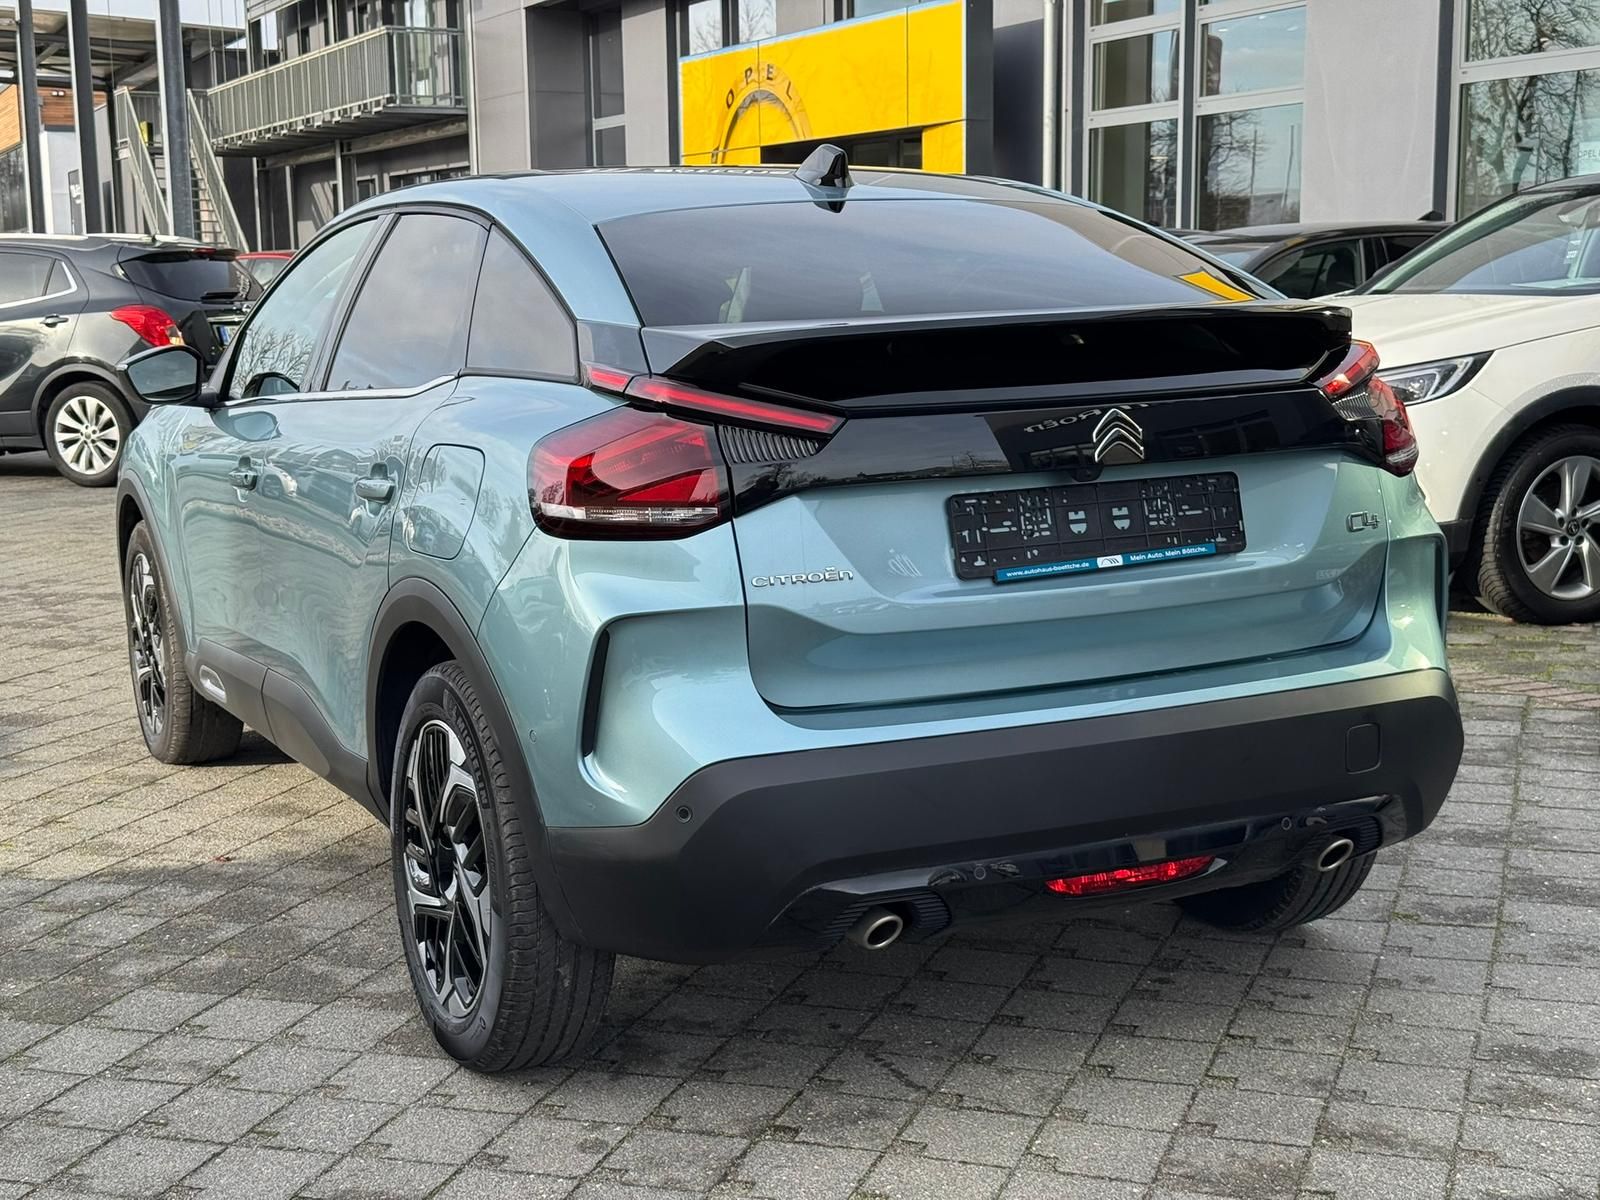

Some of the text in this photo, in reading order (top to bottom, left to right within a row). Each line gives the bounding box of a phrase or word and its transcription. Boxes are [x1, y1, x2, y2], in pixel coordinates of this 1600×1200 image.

[726, 63, 792, 110] OPEL
[1345, 510, 1380, 532] C4
[1130, 546, 1208, 561] Mein Auto. Mein Böttche.
[1006, 562, 1090, 577] www.autohaus-boettche.de
